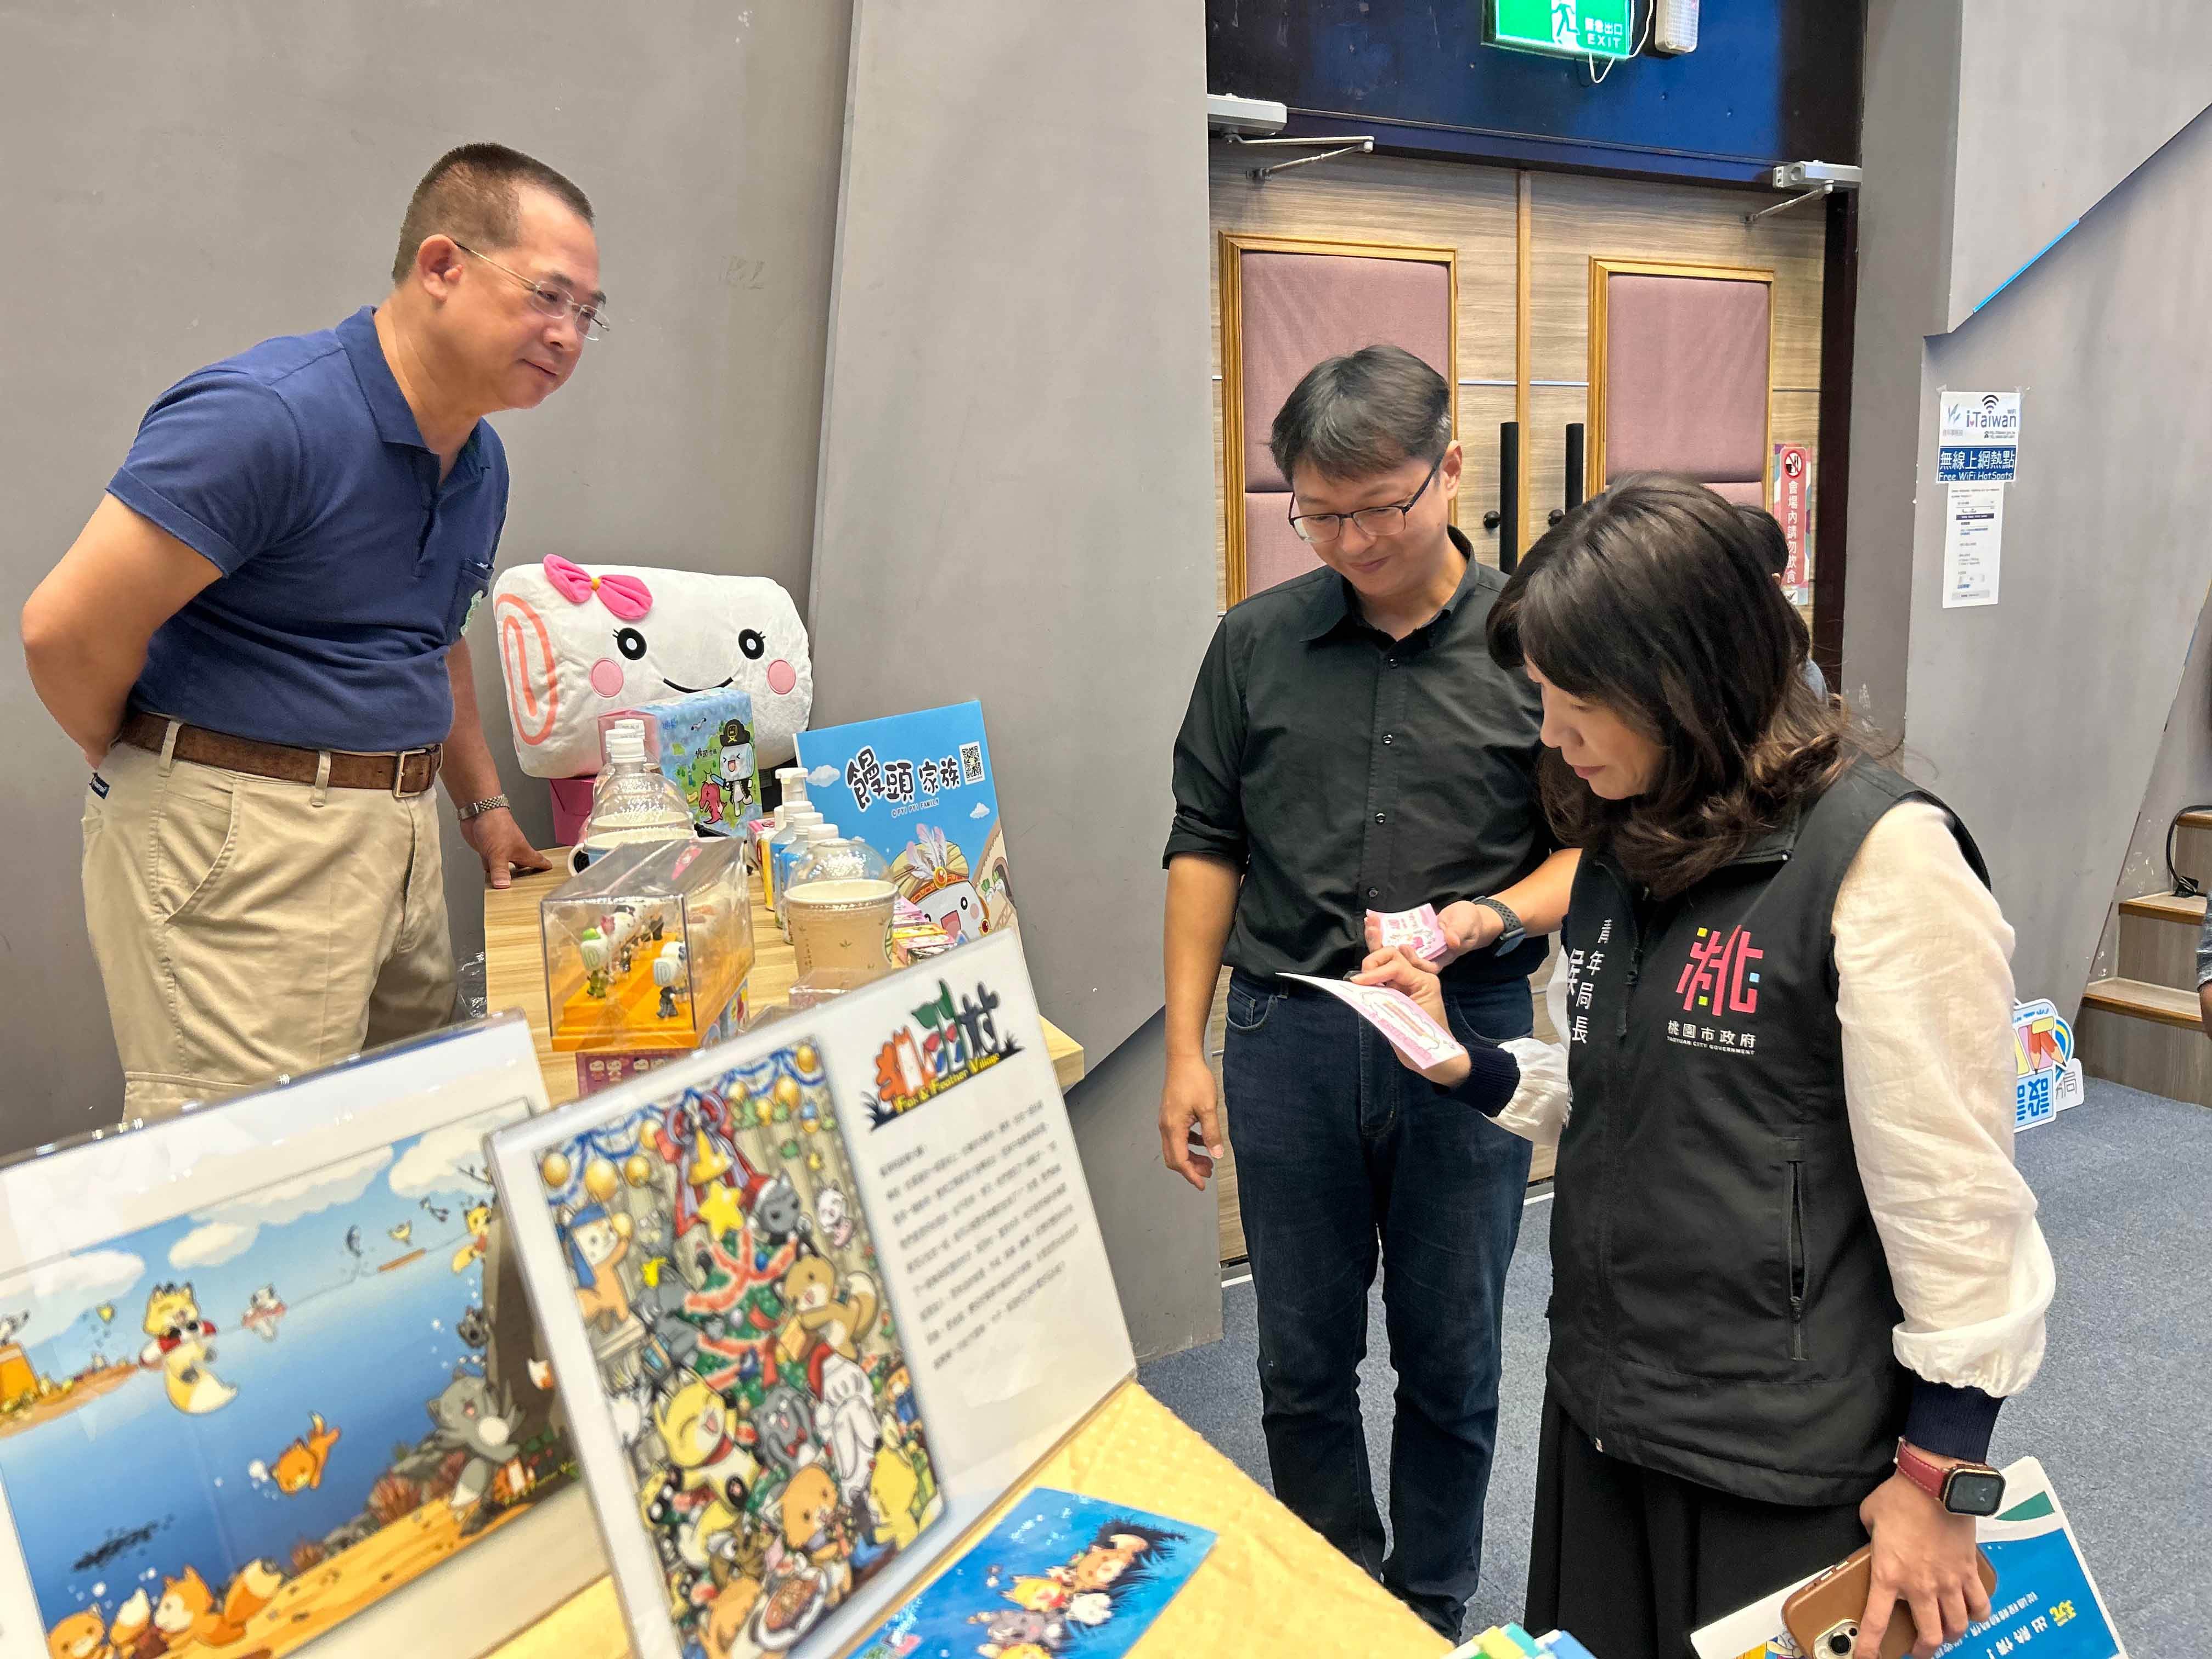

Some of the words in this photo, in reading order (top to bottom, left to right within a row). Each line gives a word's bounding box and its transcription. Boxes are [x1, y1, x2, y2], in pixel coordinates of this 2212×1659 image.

[1587, 32, 1621, 49] EXIT
[1939, 450, 2015, 470] 無線上網熱點
[1939, 471, 1956, 481] Free
[1959, 471, 1976, 481] WiFi
[1786, 480, 1799, 584] 會場內請勿飲食
[921, 799, 939, 809] FAMILY
[1667, 1019, 1756, 1048] 桃園市政府
[1667, 1036, 1691, 1046] TAOYUAN
[1709, 1044, 1756, 1056] GOVERNMENT
